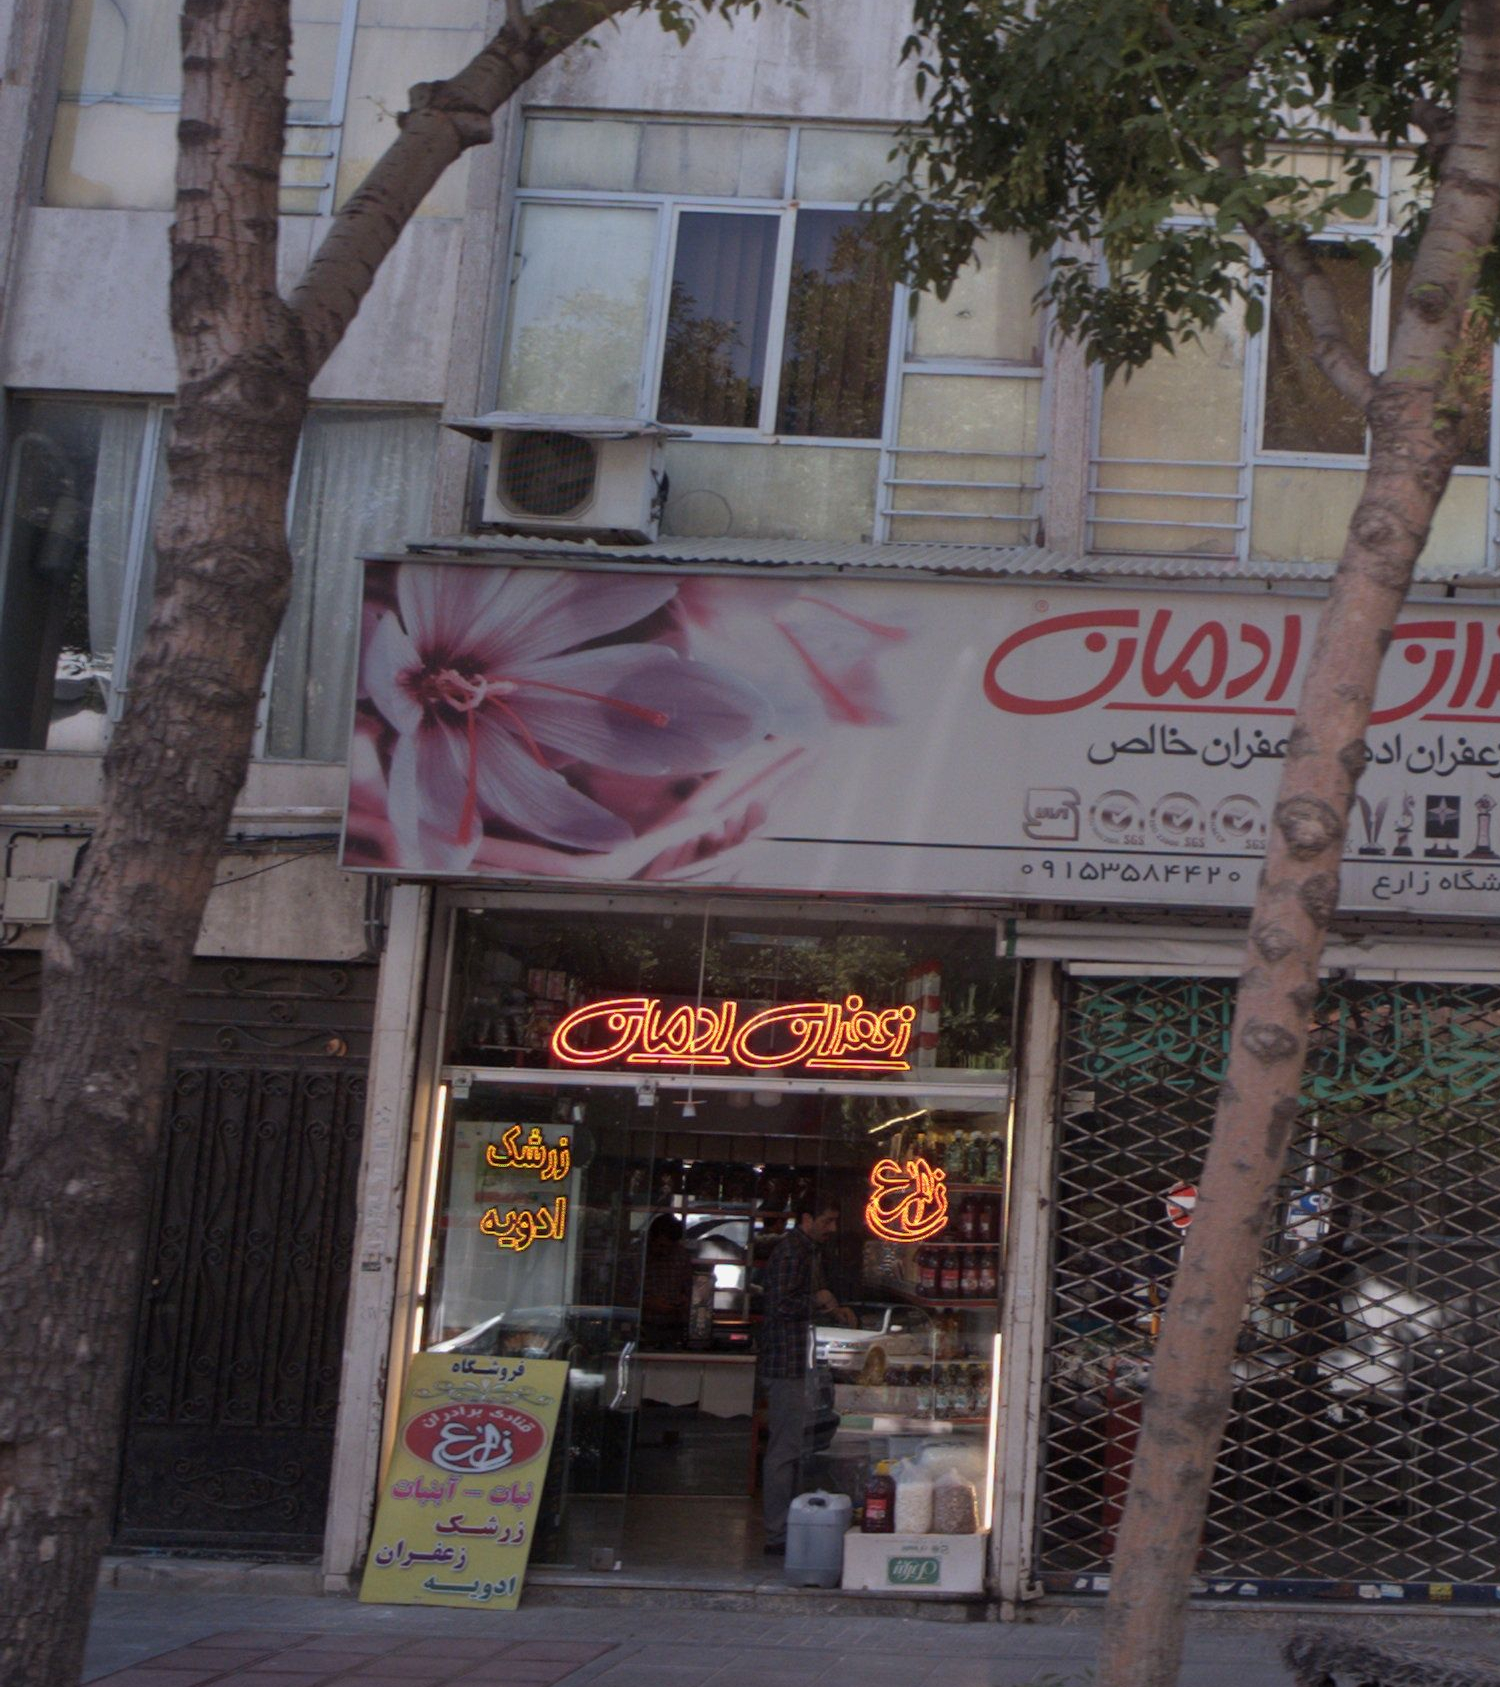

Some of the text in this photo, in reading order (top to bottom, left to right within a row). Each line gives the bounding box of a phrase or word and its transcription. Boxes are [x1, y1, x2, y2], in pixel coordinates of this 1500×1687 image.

[983, 609, 1301, 716] ادمان
[1087, 723, 1198, 765] خالص
[1201, 727, 1290, 769] عفران
[1123, 834, 1146, 846] SGS
[1184, 837, 1206, 848] SGS
[1245, 839, 1267, 850] SGS
[1371, 871, 1430, 900] زارع
[551, 994, 917, 1069] زعفران ادمان
[486, 1124, 571, 1181] زرشک
[479, 1196, 568, 1252] ادویه
[451, 1358, 526, 1382] فروشگاه
[422, 1405, 484, 1429] برادران
[487, 1480, 535, 1509] نبات
[434, 1514, 526, 1544] زرشک
[375, 1540, 468, 1570] زعفران
[422, 1575, 517, 1600] ادویه
